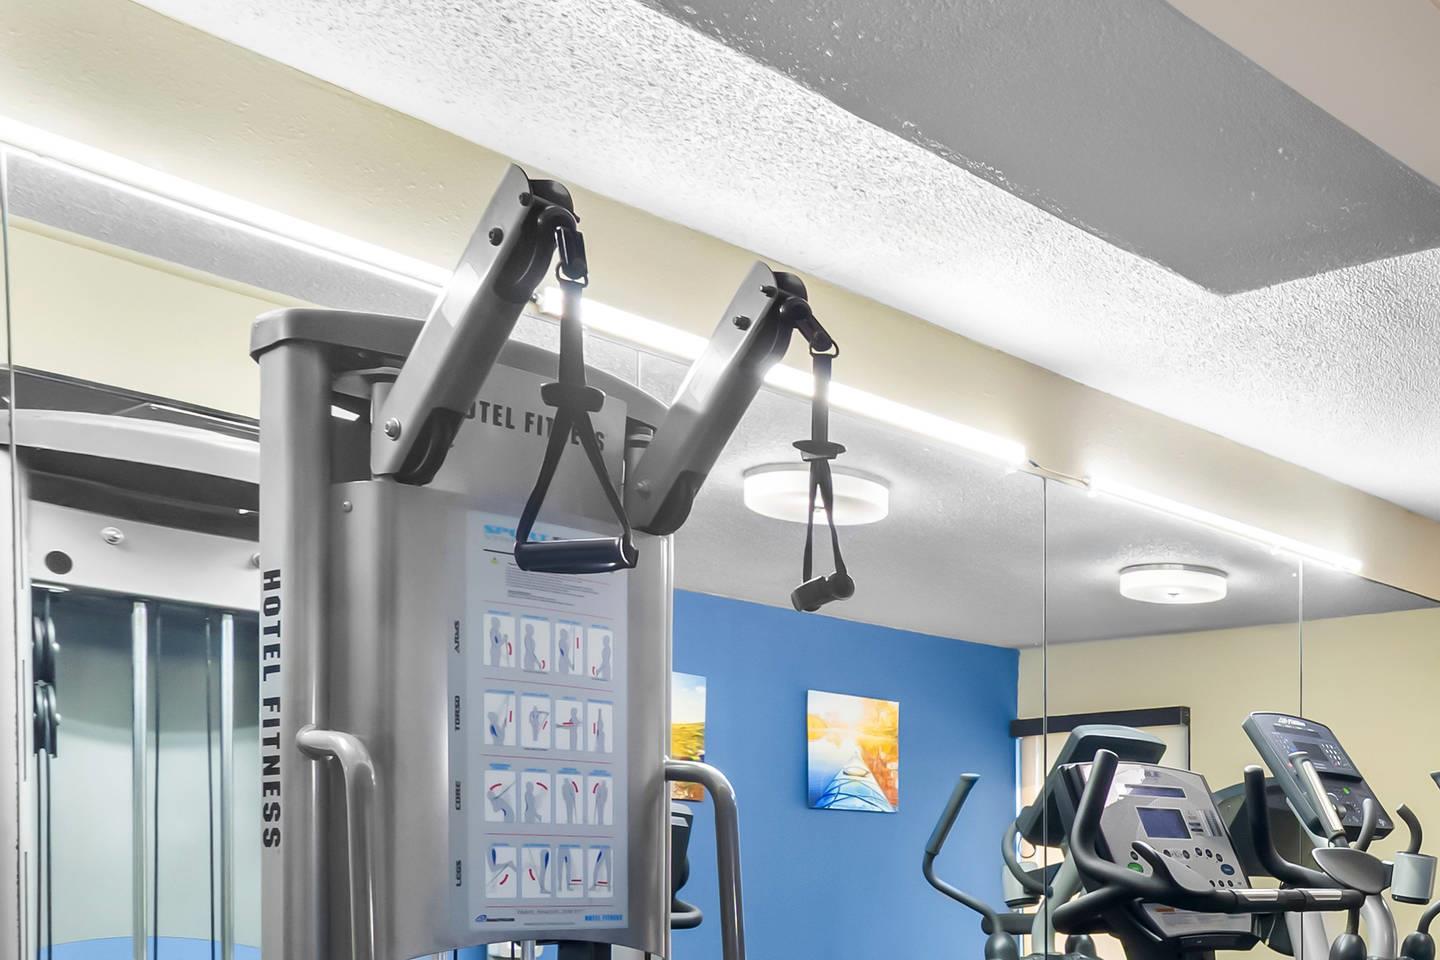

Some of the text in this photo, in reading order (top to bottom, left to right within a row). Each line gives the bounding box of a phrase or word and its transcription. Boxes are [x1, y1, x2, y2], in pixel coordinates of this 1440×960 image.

[464, 400, 515, 430] OTEL
[262, 568, 281, 849] HOTEL FITNESS
